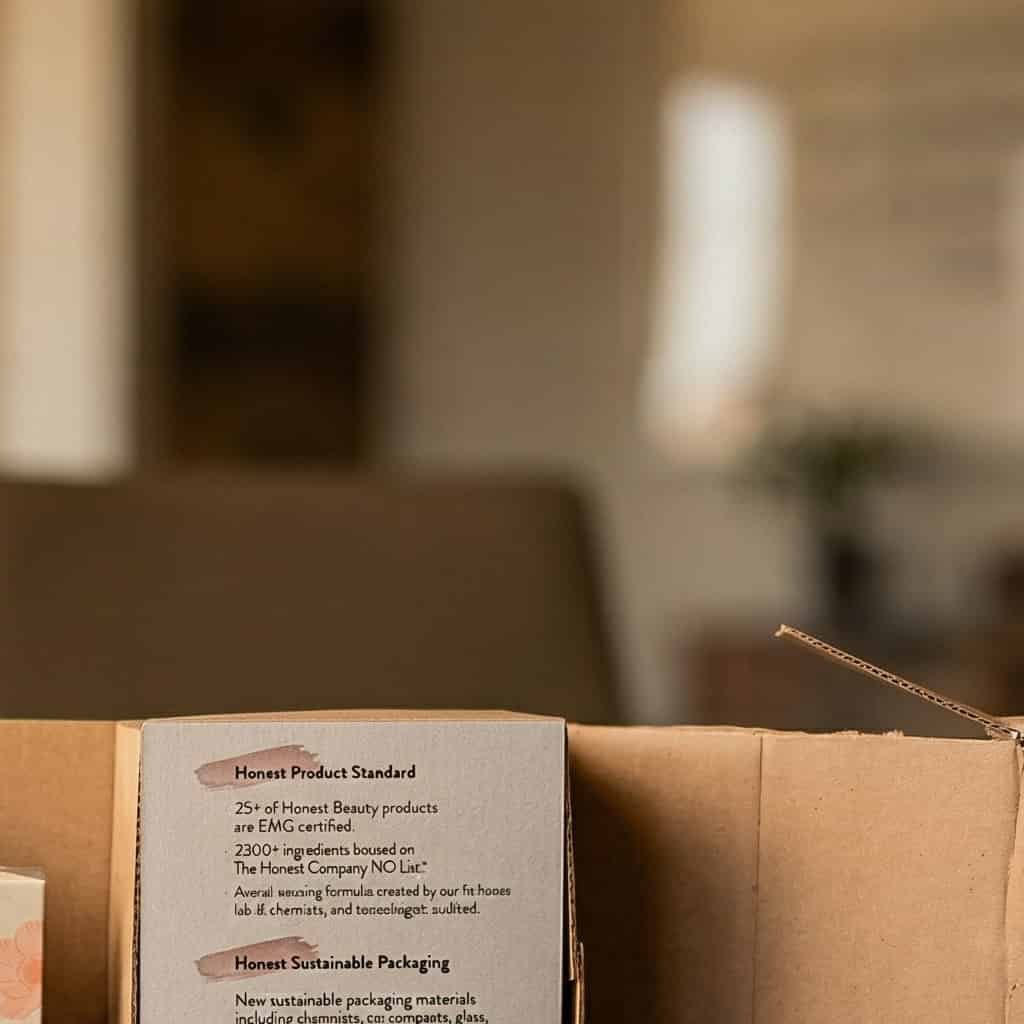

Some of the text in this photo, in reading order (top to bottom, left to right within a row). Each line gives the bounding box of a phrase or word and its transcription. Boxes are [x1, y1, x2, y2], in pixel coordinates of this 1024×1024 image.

[235, 765, 416, 779] Honest Product Standard
[235, 801, 438, 818] 25+ of Honest Beauty products
[234, 819, 355, 832] are EMG certified.
[235, 844, 279, 856] 2300+
[400, 846, 415, 855] on
[234, 862, 257, 874] The
[260, 861, 304, 874] Honest
[308, 861, 367, 878] Company
[371, 861, 396, 874] NO
[377, 886, 419, 897] created
[423, 885, 436, 900] by
[439, 889, 458, 897] our
[234, 904, 251, 916] lab
[330, 904, 353, 915] and
[235, 955, 450, 973] Honest Sustainable Packaging
[235, 992, 476, 1010] New sustainable packaging materials
